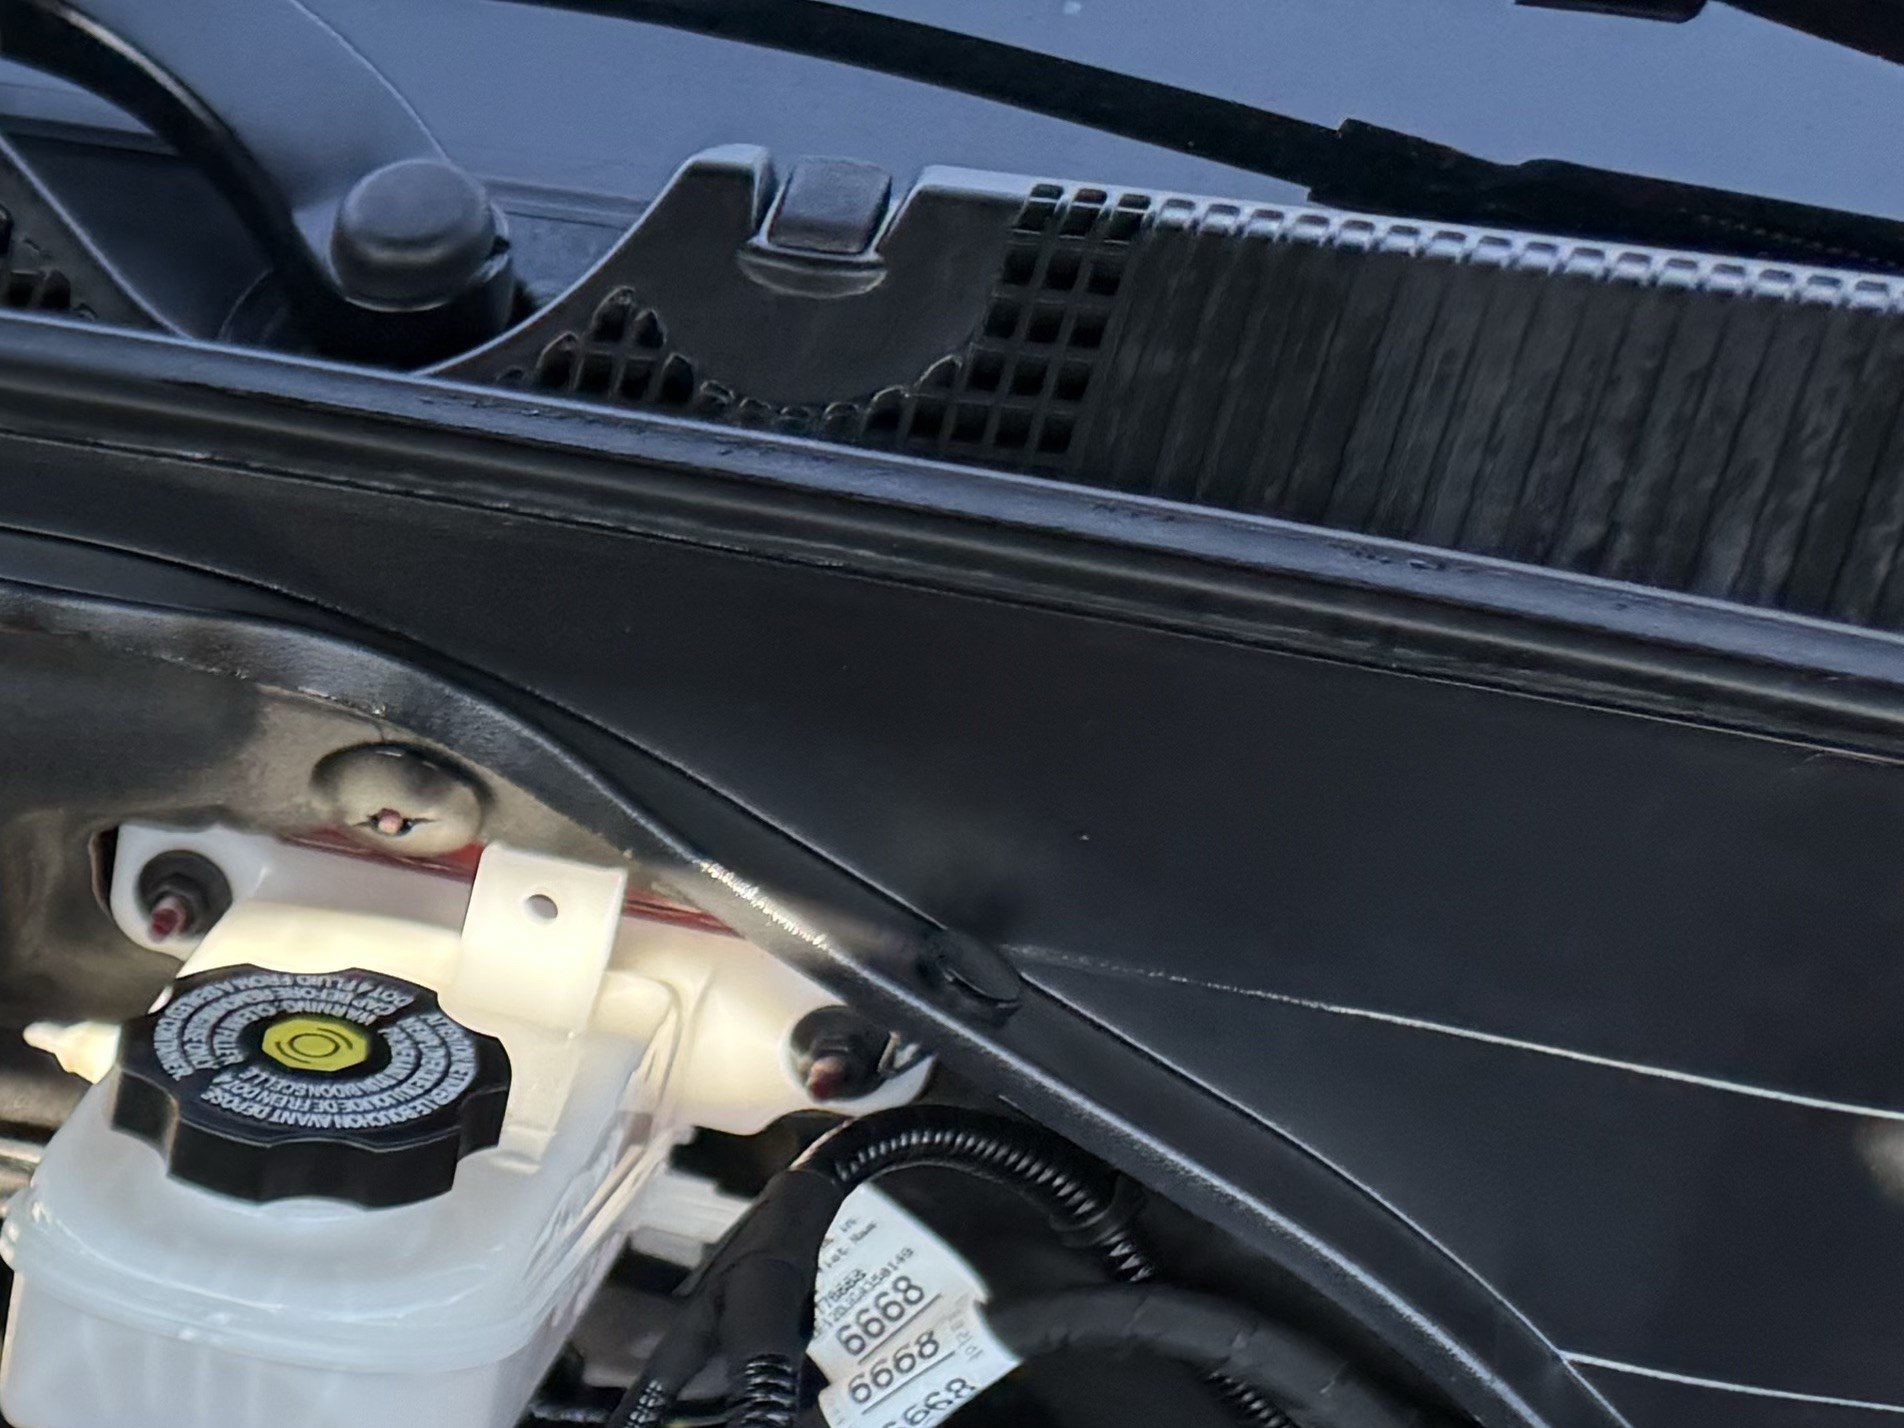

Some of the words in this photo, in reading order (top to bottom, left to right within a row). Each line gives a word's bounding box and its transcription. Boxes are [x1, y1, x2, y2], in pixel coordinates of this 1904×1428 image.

[227, 974, 294, 989] FROM
[294, 974, 358, 992] FLUID
[348, 994, 400, 1016] CAP
[366, 985, 416, 1007] DOT
[217, 1077, 264, 1100] DOT
[252, 1089, 309, 1111] FREIN
[266, 1107, 335, 1127] AVANT
[334, 1104, 421, 1128] BOUCHON
[836, 1275, 924, 1356] 6668
[848, 1330, 939, 1404] 6668
